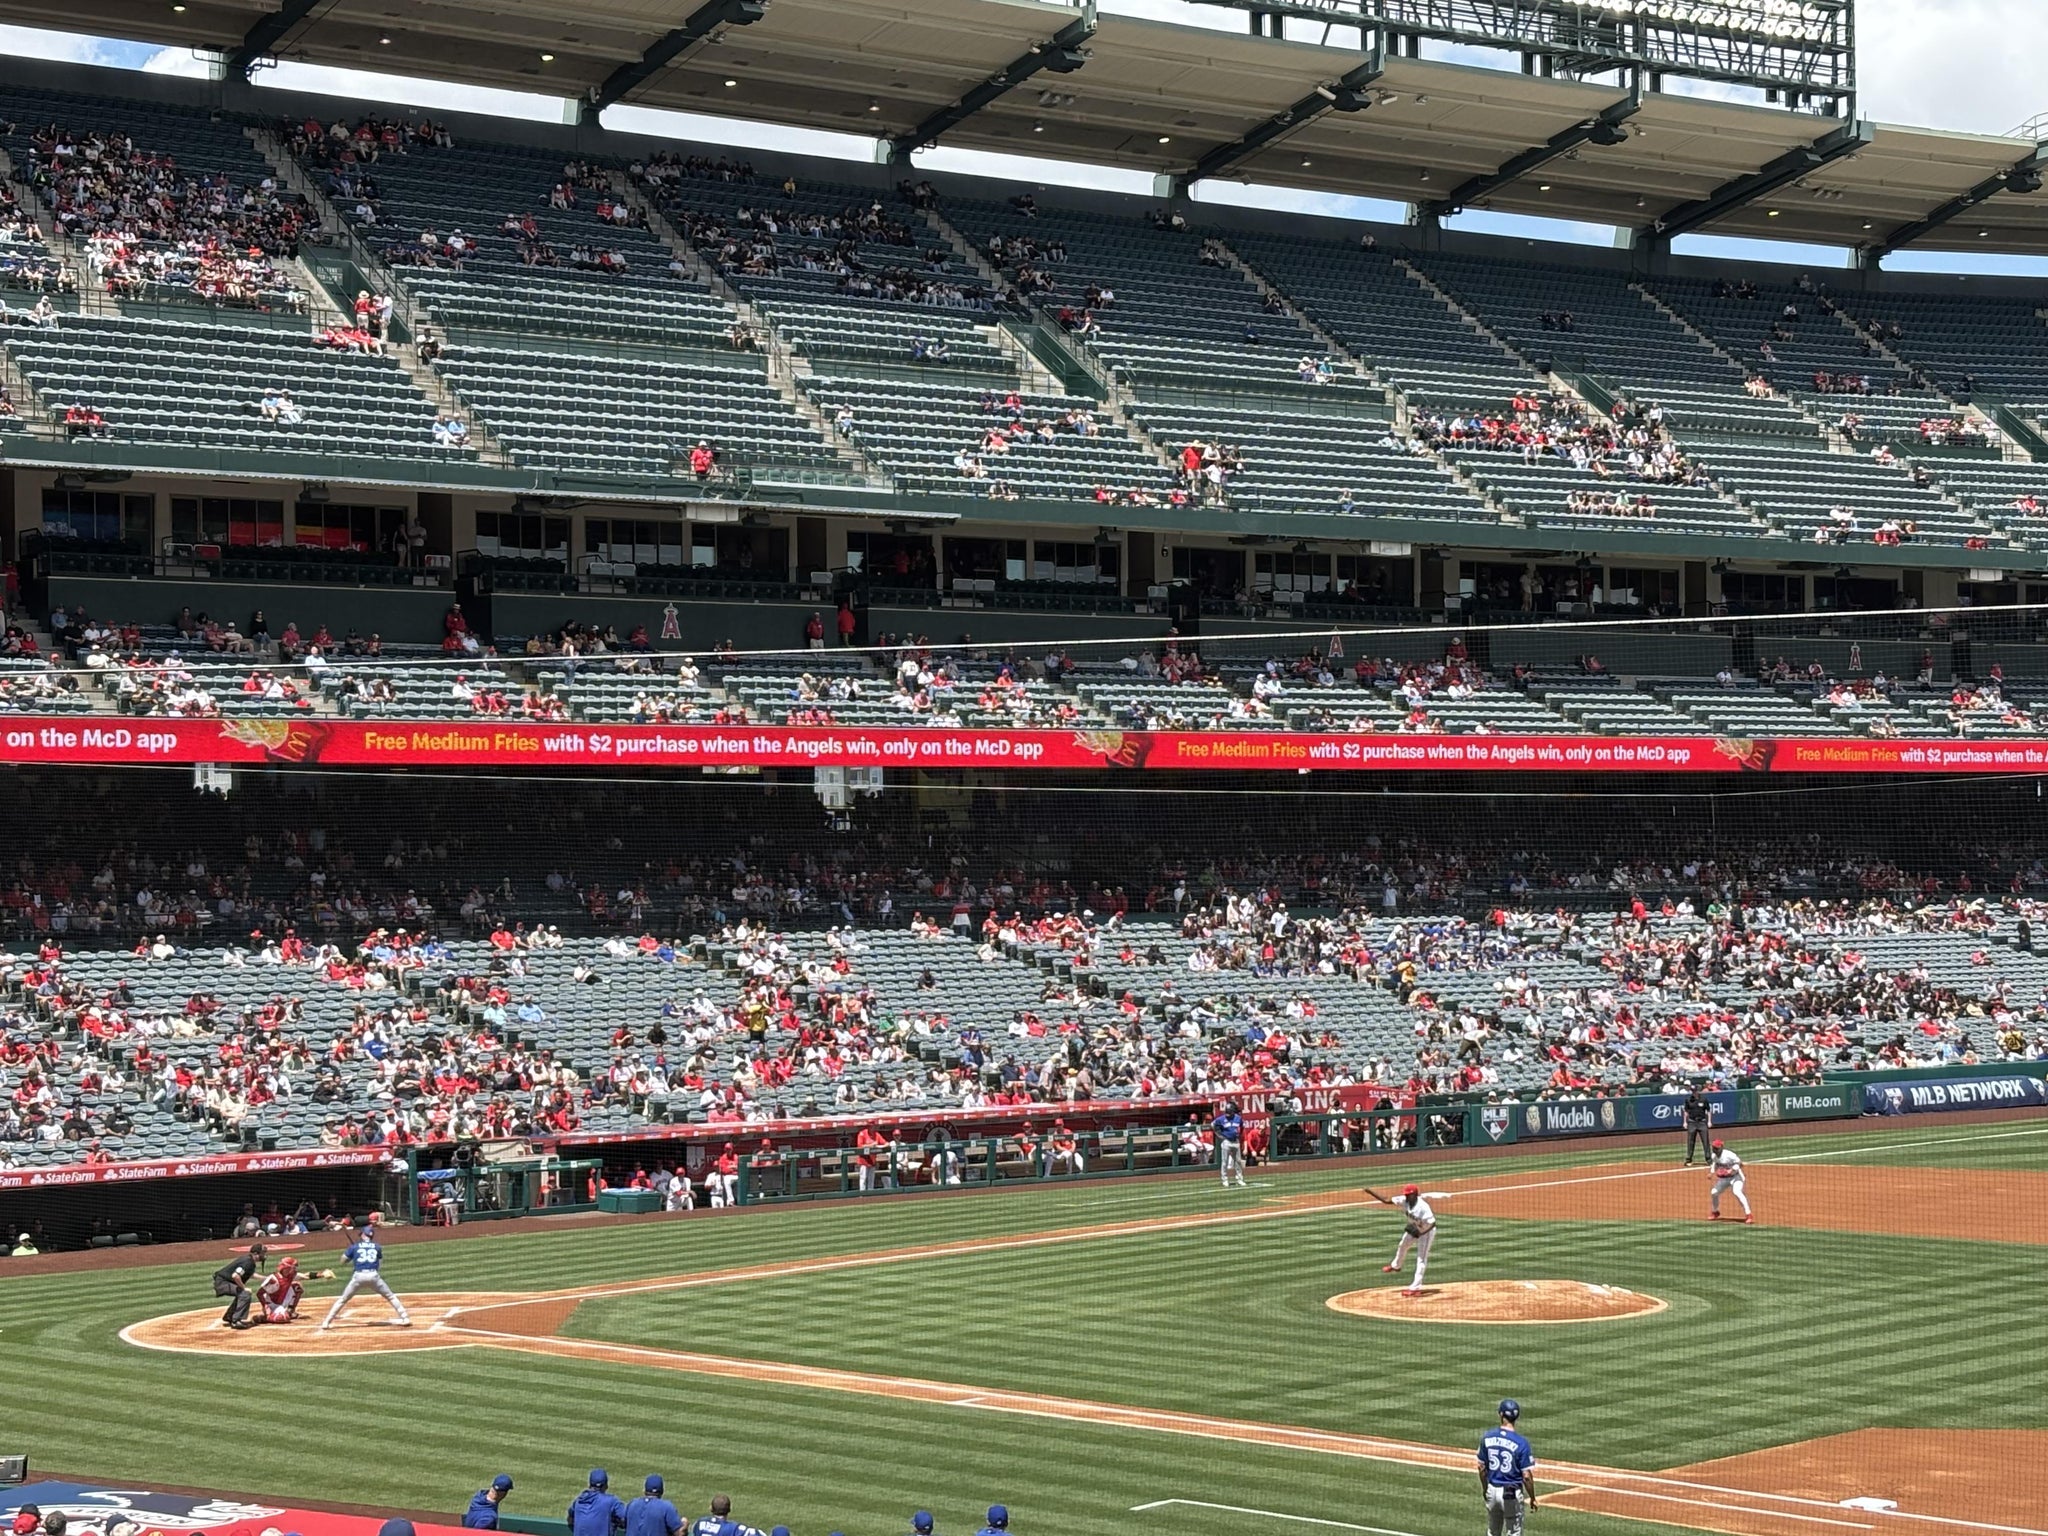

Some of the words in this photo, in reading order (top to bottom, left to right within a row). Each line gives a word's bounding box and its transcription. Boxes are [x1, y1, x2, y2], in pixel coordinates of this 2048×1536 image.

[6, 732, 35, 747] on
[40, 729, 77, 748] the
[82, 729, 131, 748] McD
[136, 733, 177, 753] app
[365, 732, 407, 750] Free
[412, 732, 489, 751] Medium
[494, 733, 539, 751] Fries
[543, 733, 584, 752] with
[589, 733, 611, 753] $2
[616, 734, 698, 756] purchase
[701, 736, 749, 754] when
[753, 736, 782, 754] the
[785, 736, 842, 757] Angels
[846, 737, 880, 757] win,
[884, 738, 917, 759] only
[921, 742, 942, 755] on
[945, 739, 972, 756] the
[975, 739, 1011, 756] McD
[1014, 743, 1044, 760] app
[1178, 742, 1208, 757] Free
[1212, 742, 1269, 757] Medium
[1273, 742, 1306, 758] Fries
[1309, 742, 1340, 758] with
[1343, 742, 1360, 759] $2
[1363, 743, 1425, 762] purchase
[1428, 744, 1463, 759] when
[1466, 744, 1488, 759] the
[1491, 744, 1535, 763] Angels
[1537, 744, 1564, 762] win,
[1566, 745, 1592, 764] only
[1595, 749, 1611, 760] on
[1614, 746, 1634, 761] the
[1637, 746, 1664, 761] McD
[1667, 749, 1690, 764] app
[1797, 747, 1820, 761] Free
[1824, 747, 1869, 761] Medium
[1872, 748, 1897, 761] Fries
[1900, 748, 1925, 762] with
[1927, 748, 1940, 764] $2
[1943, 748, 1992, 765] purchase
[1995, 748, 2022, 763] when
[2025, 748, 2044, 763] the
[1785, 1095, 1841, 1110] FMB.com
[1911, 1086, 1947, 1106] MLB
[1950, 1081, 2026, 1104] NETWORK
[1483, 1107, 1507, 1119] MLB
[1547, 1105, 1595, 1129] Modelo
[357, 1248, 378, 1263] 38
[1487, 1448, 1513, 1474] 53
